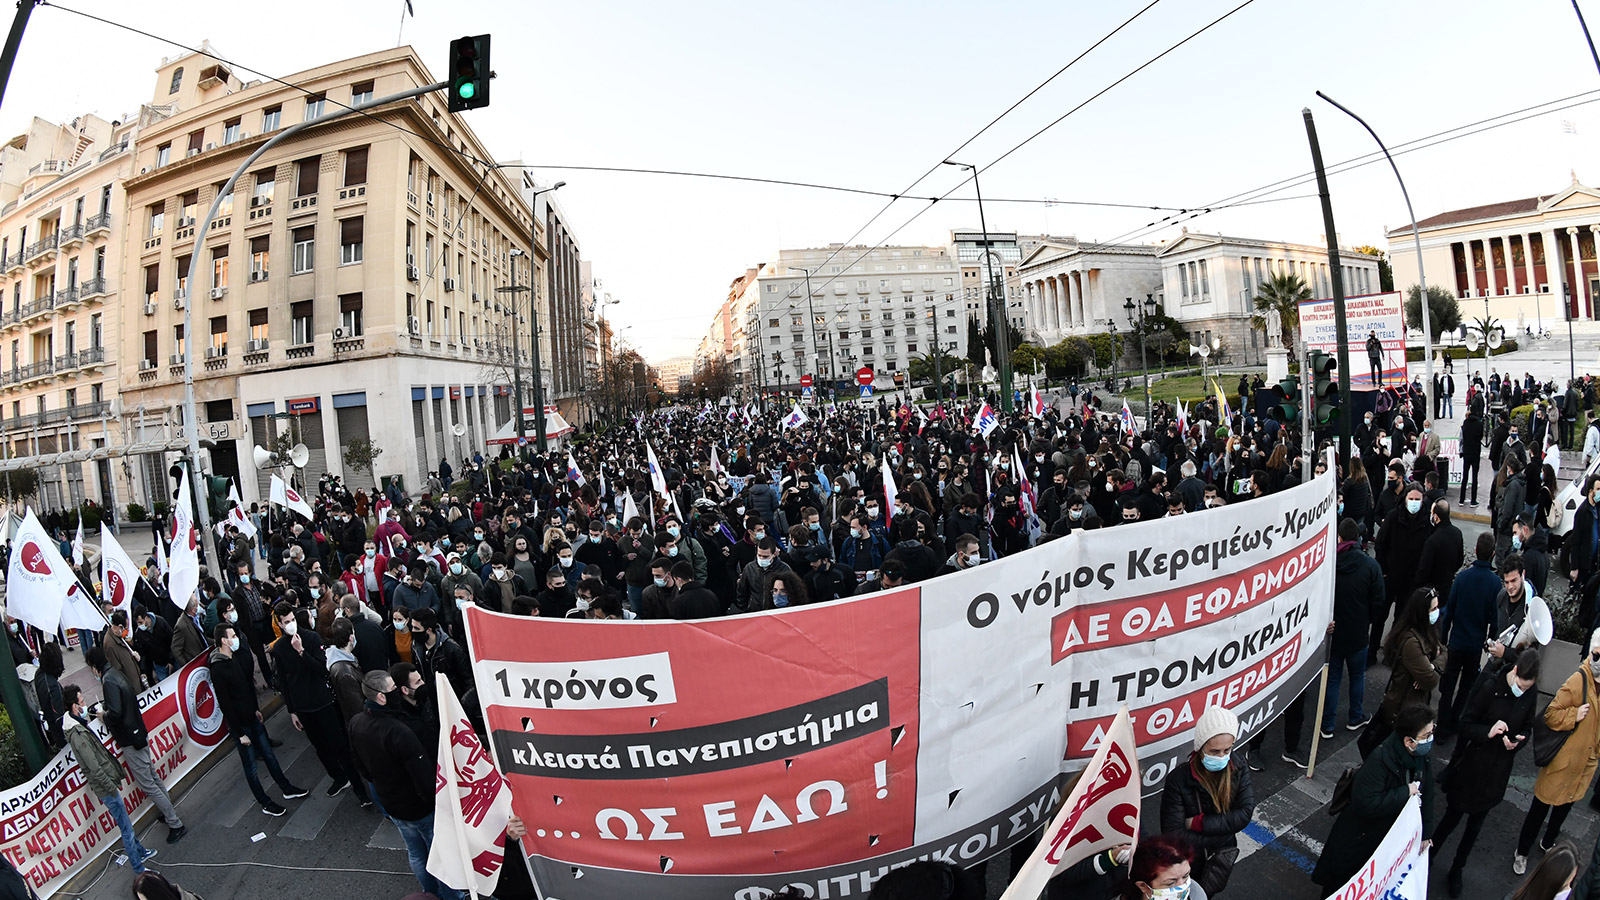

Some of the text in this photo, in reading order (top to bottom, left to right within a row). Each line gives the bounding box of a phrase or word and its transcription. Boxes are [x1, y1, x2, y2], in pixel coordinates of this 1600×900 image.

[1367, 322, 1386, 330] ΑΓΩΝΑ
[966, 592, 1000, 629] Ο
[1011, 562, 1115, 614] νόμος
[1060, 533, 1327, 653] ΔΕ ΘΑ ΕΦΑΡΜΟΣΤΕΙ
[1069, 598, 1309, 710] Η ΤΡΟΜΟΚΡΑΤΙΑ
[1146, 699, 1194, 735] ΘΑ
[1204, 637, 1299, 714] ΠΕΡΑΣΕΙ
[495, 668, 658, 708] 1 χρόνος
[512, 701, 879, 770] κλειστά Πανεπιστήμια
[1, 760, 64, 816] ΑΡΧΙΣΜΟΣ
[3, 809, 40, 840] ΔΕΝ
[43, 789, 65, 814] ΘΑ
[24, 856, 61, 889] ΓΕΙΑΣ
[56, 839, 81, 870] ΚΑΙ
[79, 826, 102, 853] ΤΟΥ
[169, 743, 187, 773] ΜΑΣ
[595, 807, 685, 841] ΩΣ
[703, 780, 848, 837] ΕΔΩ
[25, 811, 74, 859] ΜΕΤΡΑ
[69, 792, 96, 827] ΓΙΑ
